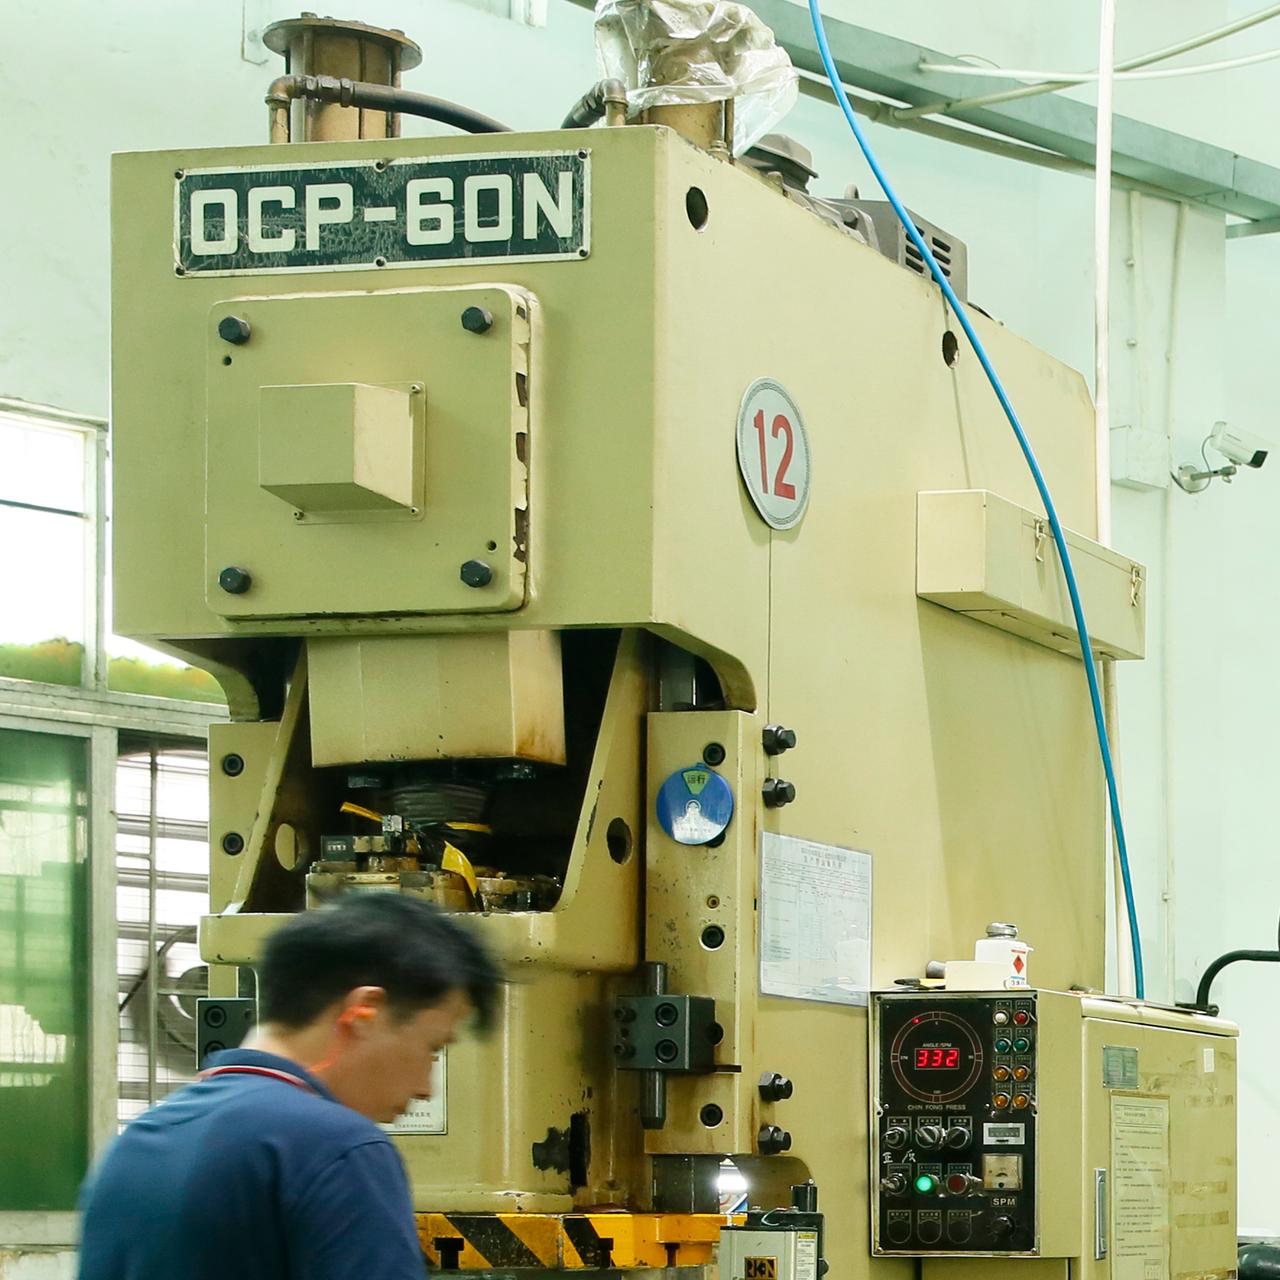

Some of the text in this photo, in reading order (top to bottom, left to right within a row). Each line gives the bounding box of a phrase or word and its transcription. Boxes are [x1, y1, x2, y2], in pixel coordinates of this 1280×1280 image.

[190, 169, 576, 256] OCP-60N
[753, 408, 797, 501] 12
[916, 1050, 958, 1067] 332
[992, 1198, 1016, 1206] SPM
